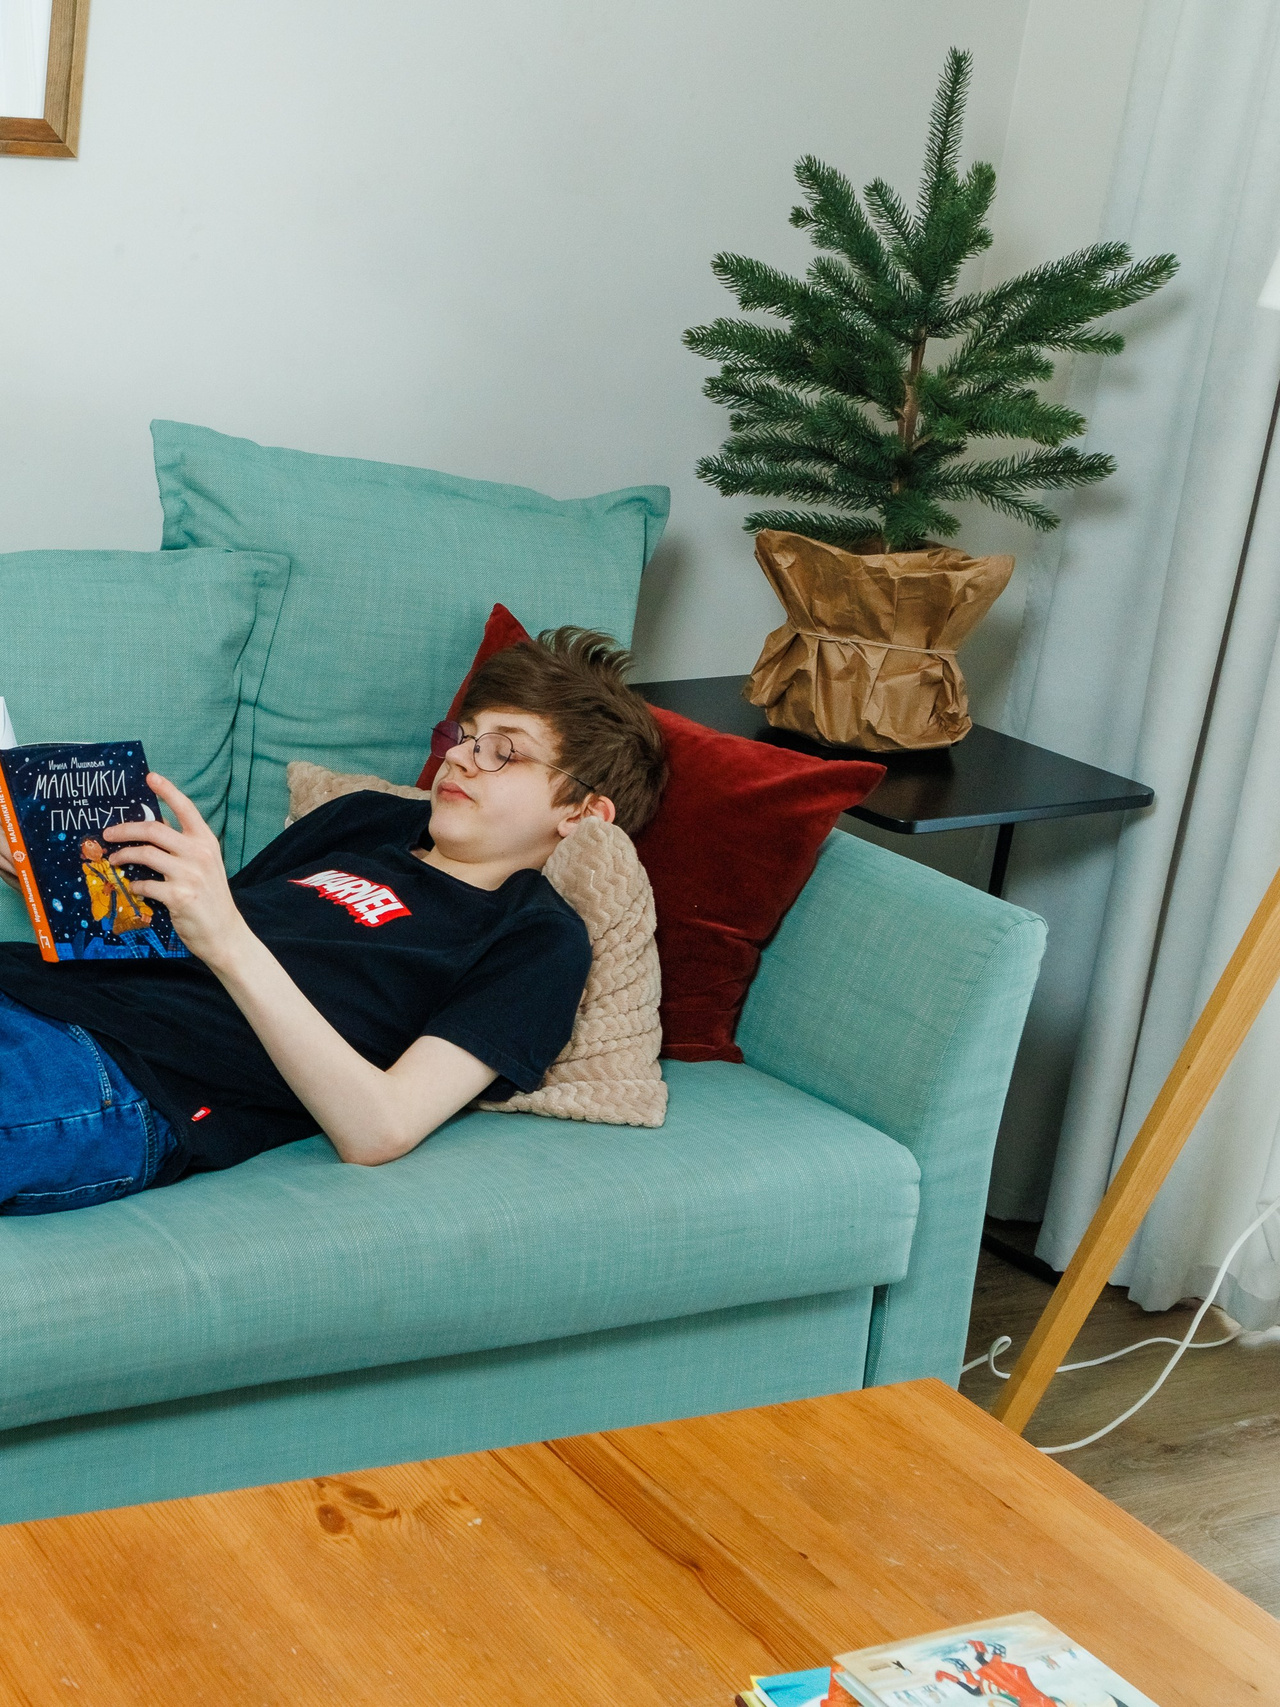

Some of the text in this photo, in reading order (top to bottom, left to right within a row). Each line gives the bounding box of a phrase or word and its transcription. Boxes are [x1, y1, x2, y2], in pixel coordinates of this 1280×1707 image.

[33, 769, 127, 800] МАЛЬЧИКИ
[1, 804, 18, 843] МАЛЬЧИКИ
[51, 806, 131, 831] ПЛАЧУТ
[297, 870, 404, 925] MARVEL
